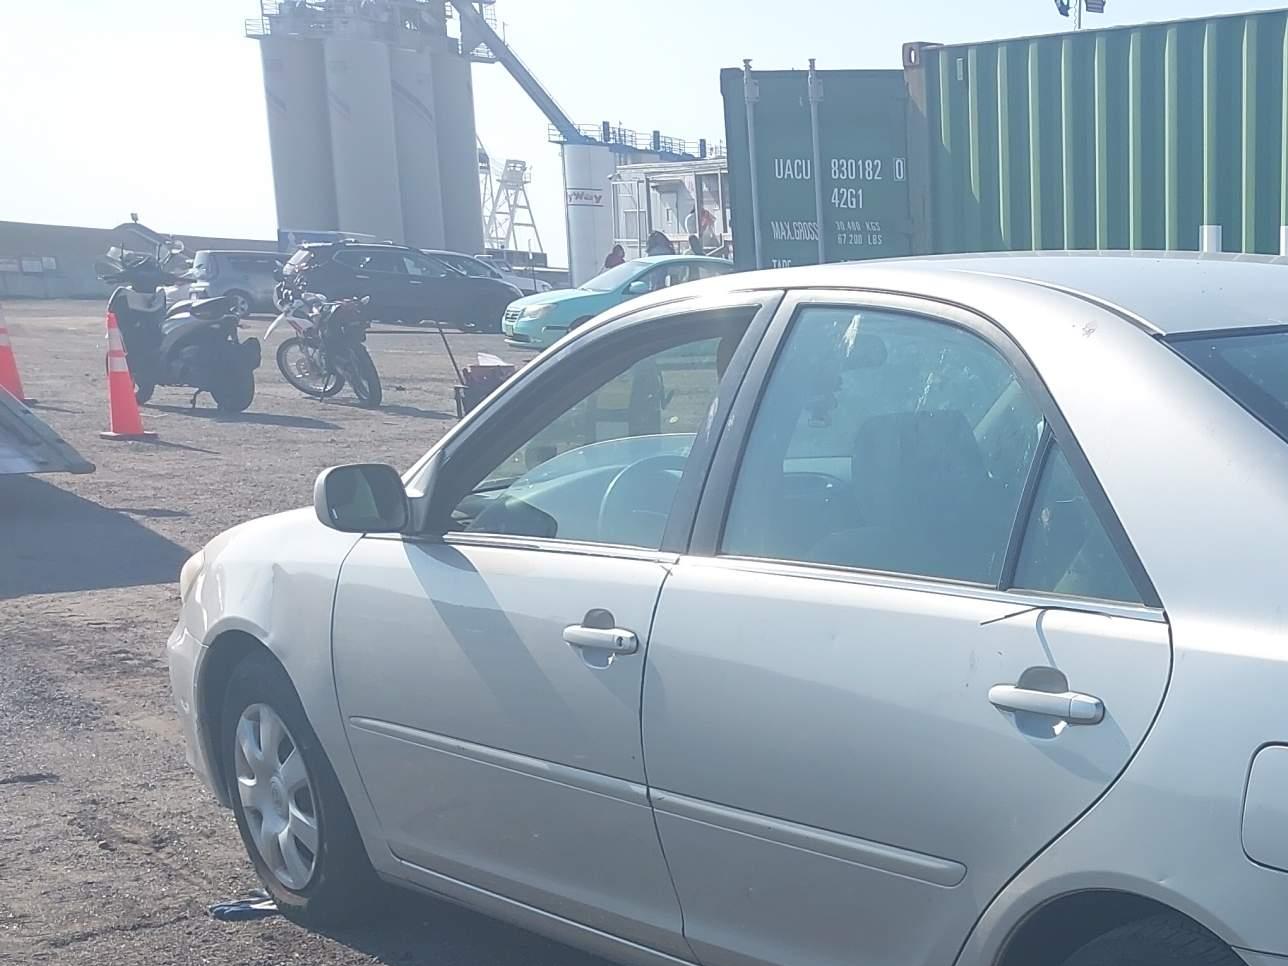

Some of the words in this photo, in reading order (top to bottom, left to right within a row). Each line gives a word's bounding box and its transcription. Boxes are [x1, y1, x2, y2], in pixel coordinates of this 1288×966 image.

[774, 158, 811, 180] UACU
[831, 158, 882, 180] 830182
[894, 158, 905, 181] 0
[831, 187, 863, 209] 42G1
[867, 234, 883, 246] LBS
